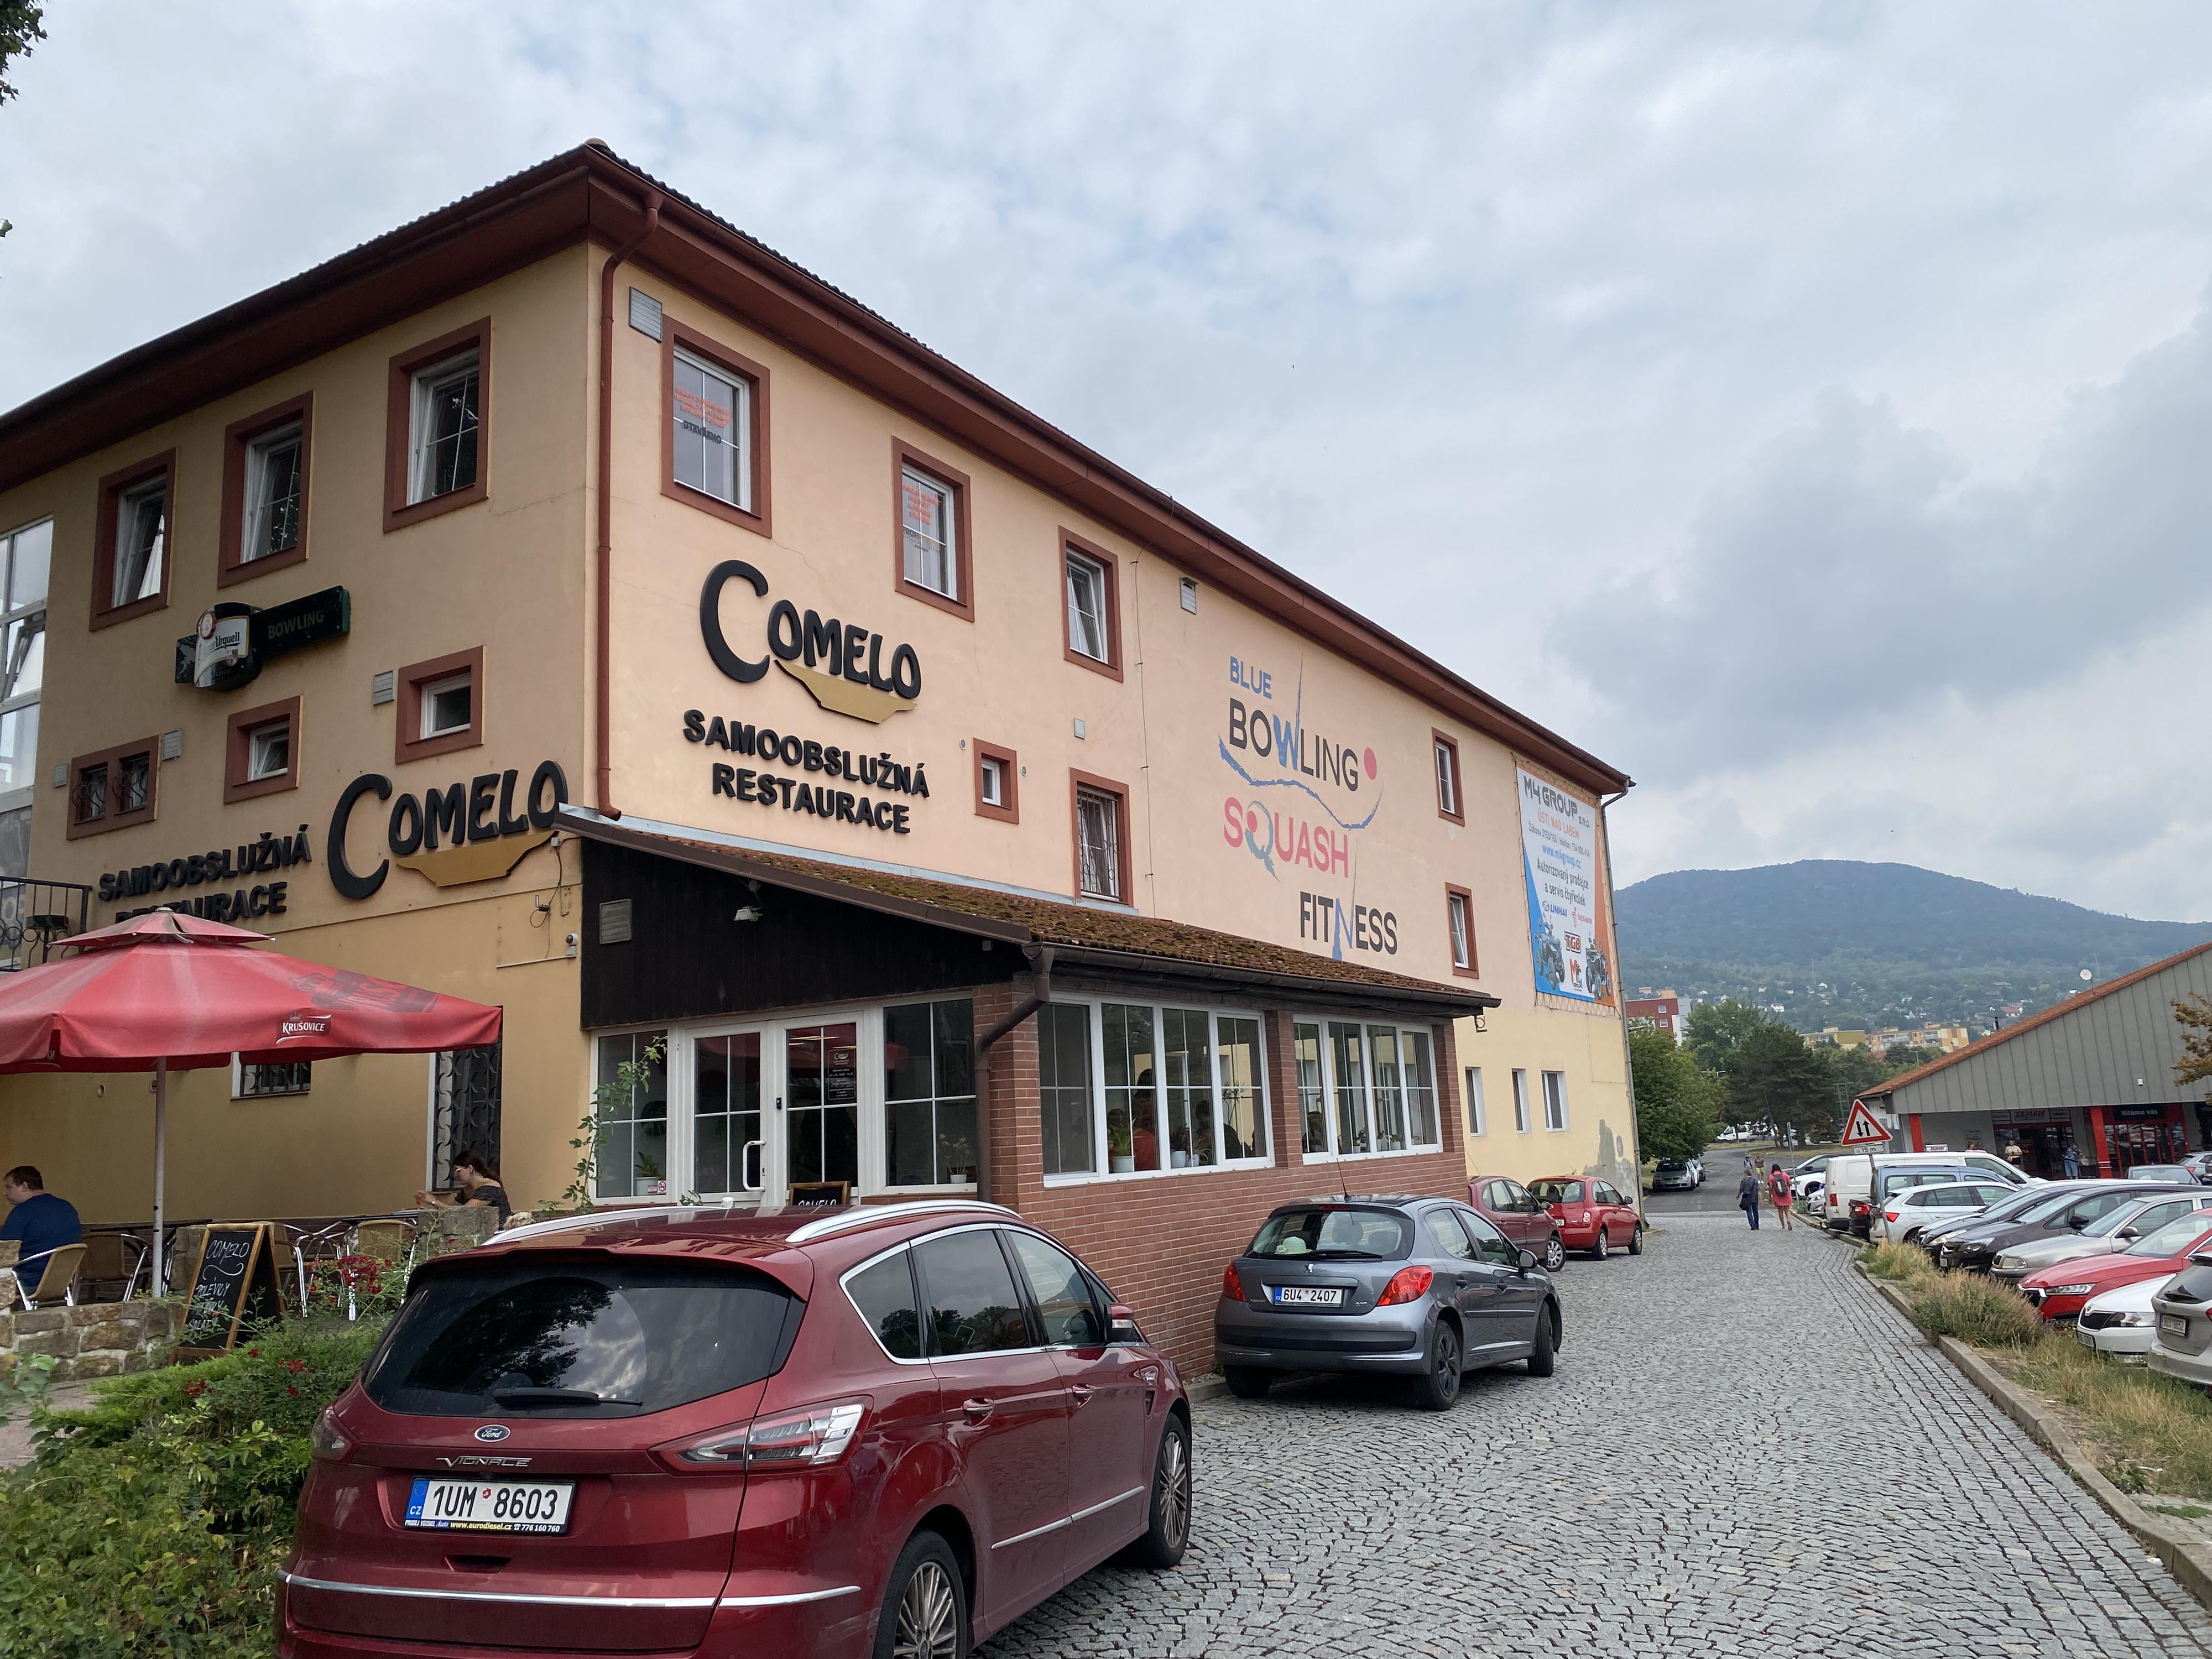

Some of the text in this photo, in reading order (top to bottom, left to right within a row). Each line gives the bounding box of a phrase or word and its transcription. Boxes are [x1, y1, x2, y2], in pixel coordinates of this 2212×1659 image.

[215, 632, 240, 648] Urquell
[268, 609, 325, 640] BOWLING
[1230, 656, 1272, 700] BLUE
[683, 709, 930, 798] SAMOOBSLUŽNÁ
[1229, 697, 1359, 792] BOWLING
[712, 763, 911, 833] RESTAURACE
[1524, 775, 1541, 805] M4
[1542, 786, 1578, 820] GROUP
[1223, 797, 1348, 883] SQUASH
[1551, 816, 1562, 831] NAD
[1563, 821, 1579, 839] LABEM
[98, 823, 312, 902] SAMOOBSLUŽNÁ
[1537, 857, 1589, 891] Autorizovaný prodejce
[1545, 883, 1587, 907] a servis čtyřkolek
[1550, 904, 1567, 917] LINHAI
[1300, 891, 1397, 960] FITNESS
[1565, 933, 1581, 952] TGB
[206, 1239, 249, 1265] COMELO
[1284, 1289, 1337, 1302] 6U4 2407
[481, 1428, 503, 1438] Ford
[410, 1505, 422, 1515] CZ
[433, 1485, 558, 1520] 1UM 8603
[450, 1522, 513, 1531] www.eurodiesel.cz
